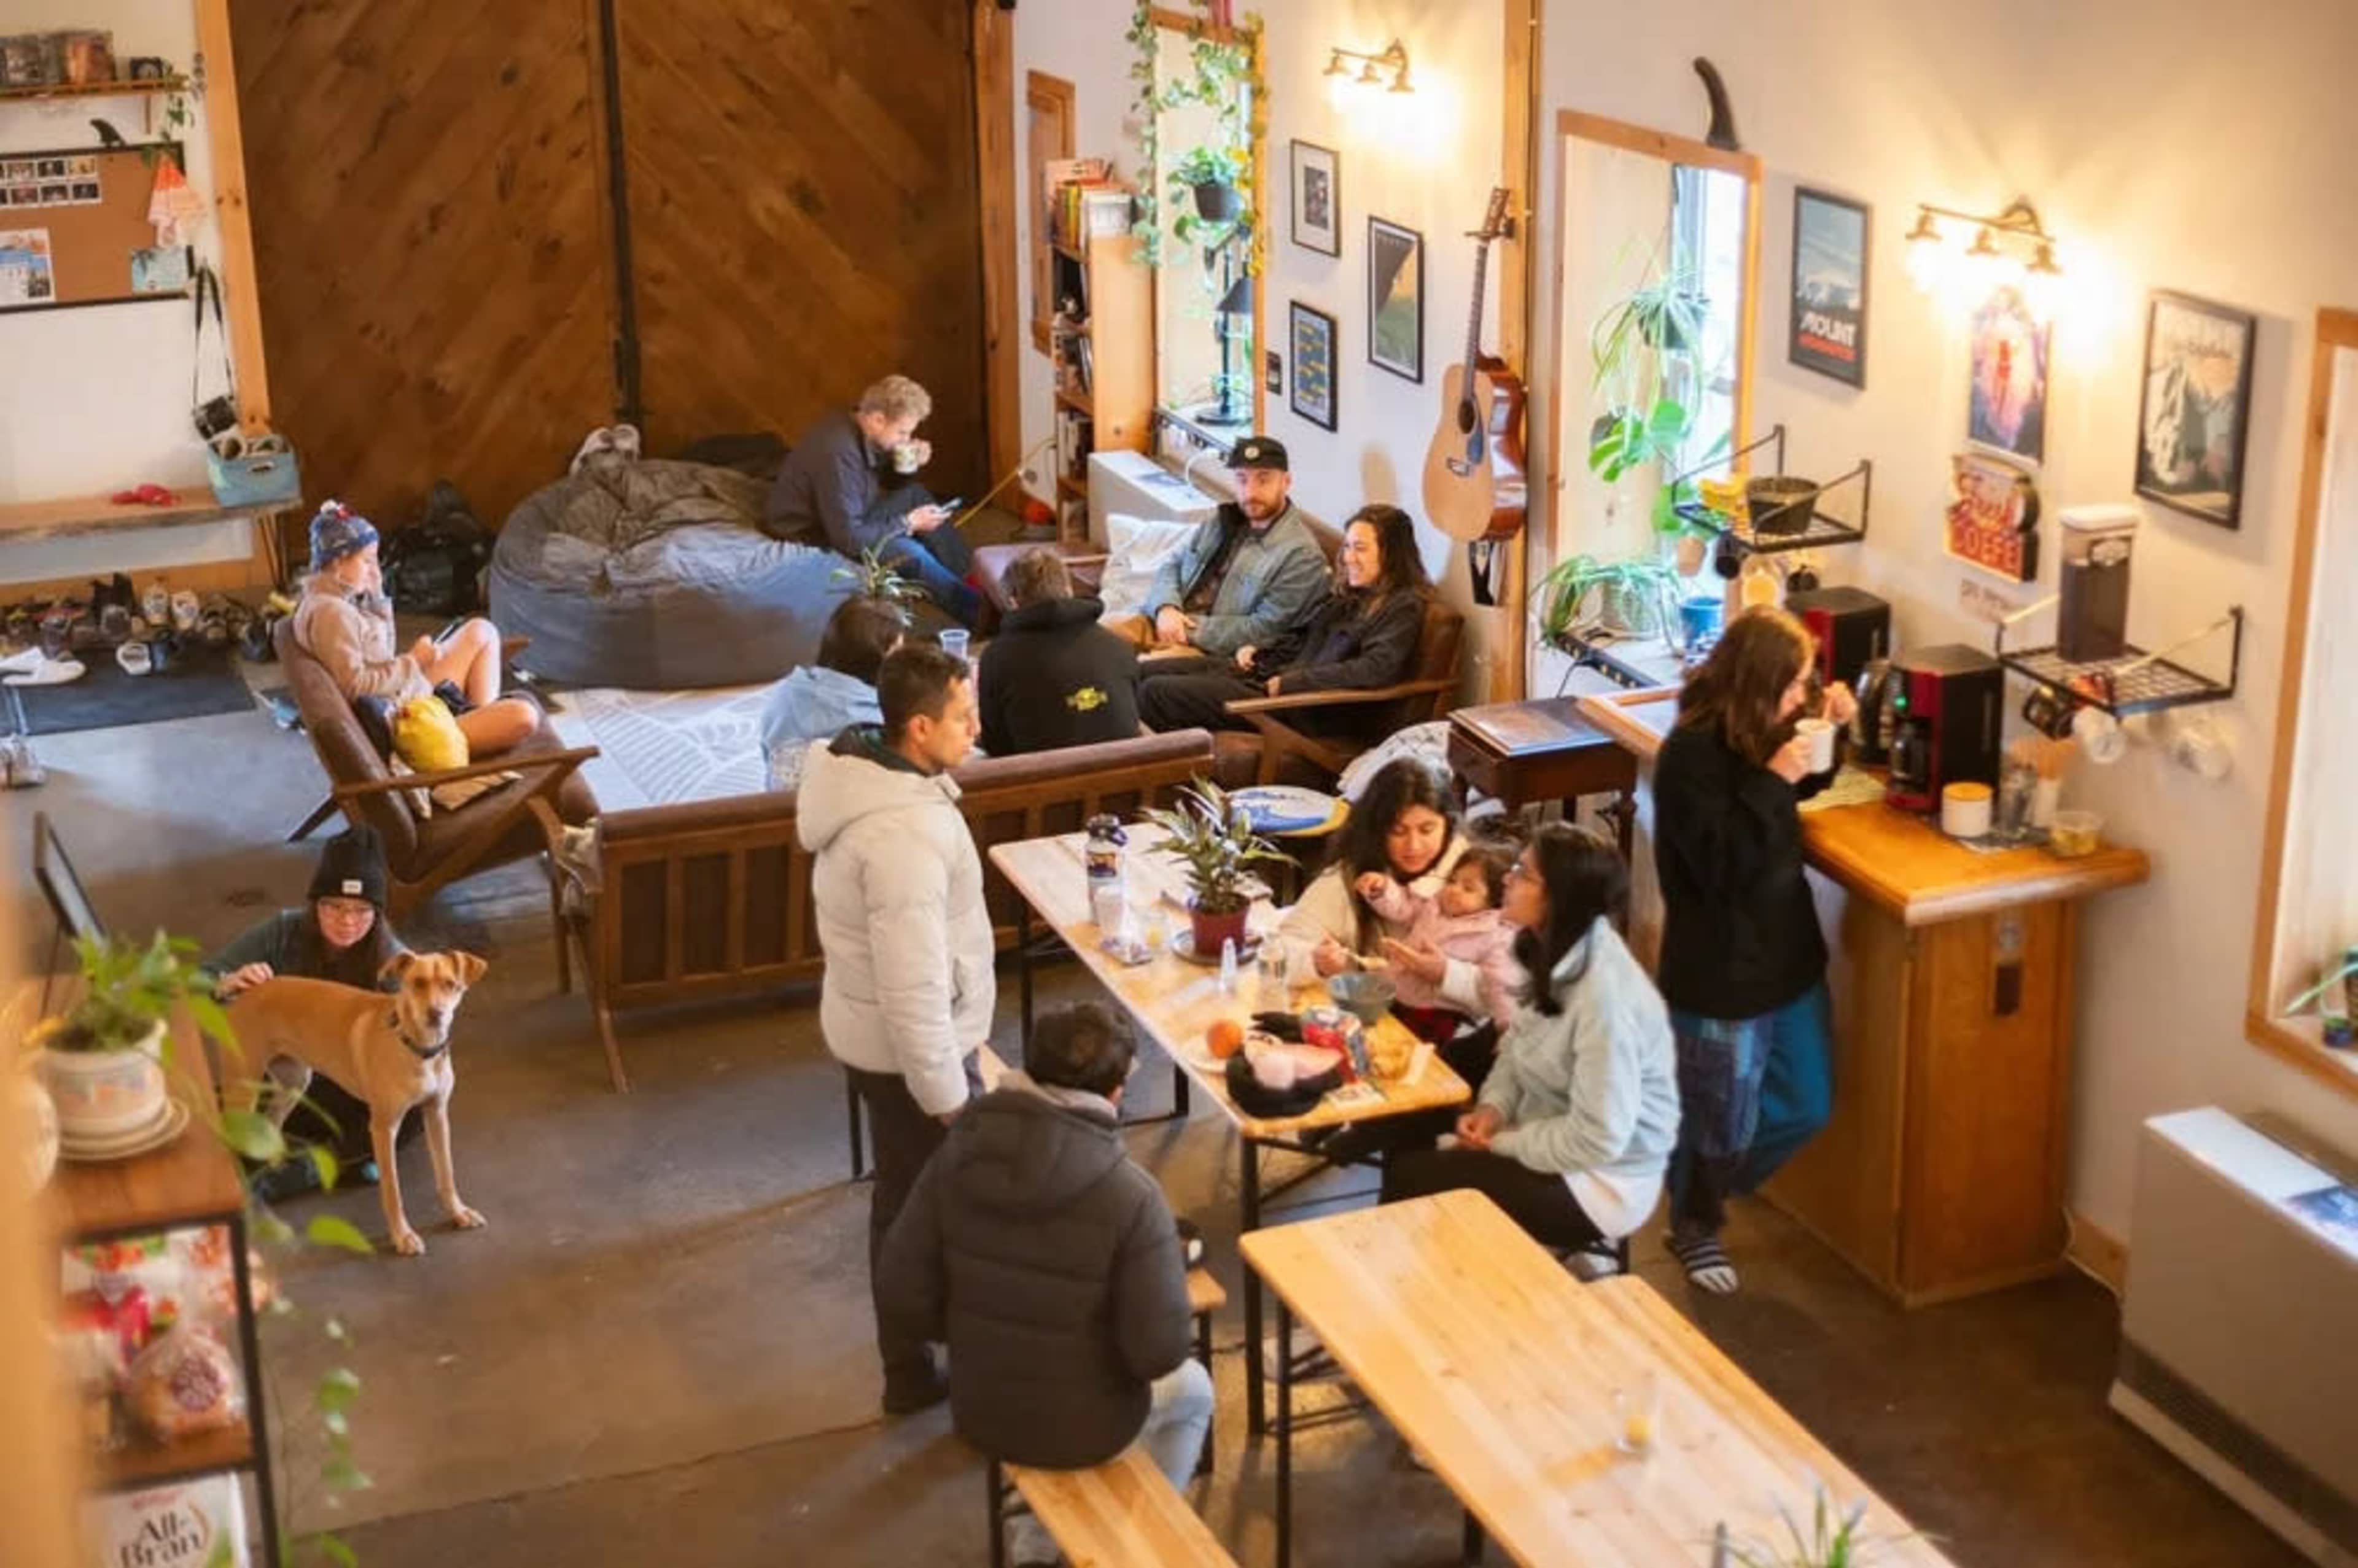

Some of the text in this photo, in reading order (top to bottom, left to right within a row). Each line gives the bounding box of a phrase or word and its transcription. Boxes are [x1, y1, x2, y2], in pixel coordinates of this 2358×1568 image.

[1799, 311, 1856, 347] MOUNT
[135, 1510, 189, 1546] All-
[119, 1532, 203, 1568] Bran
